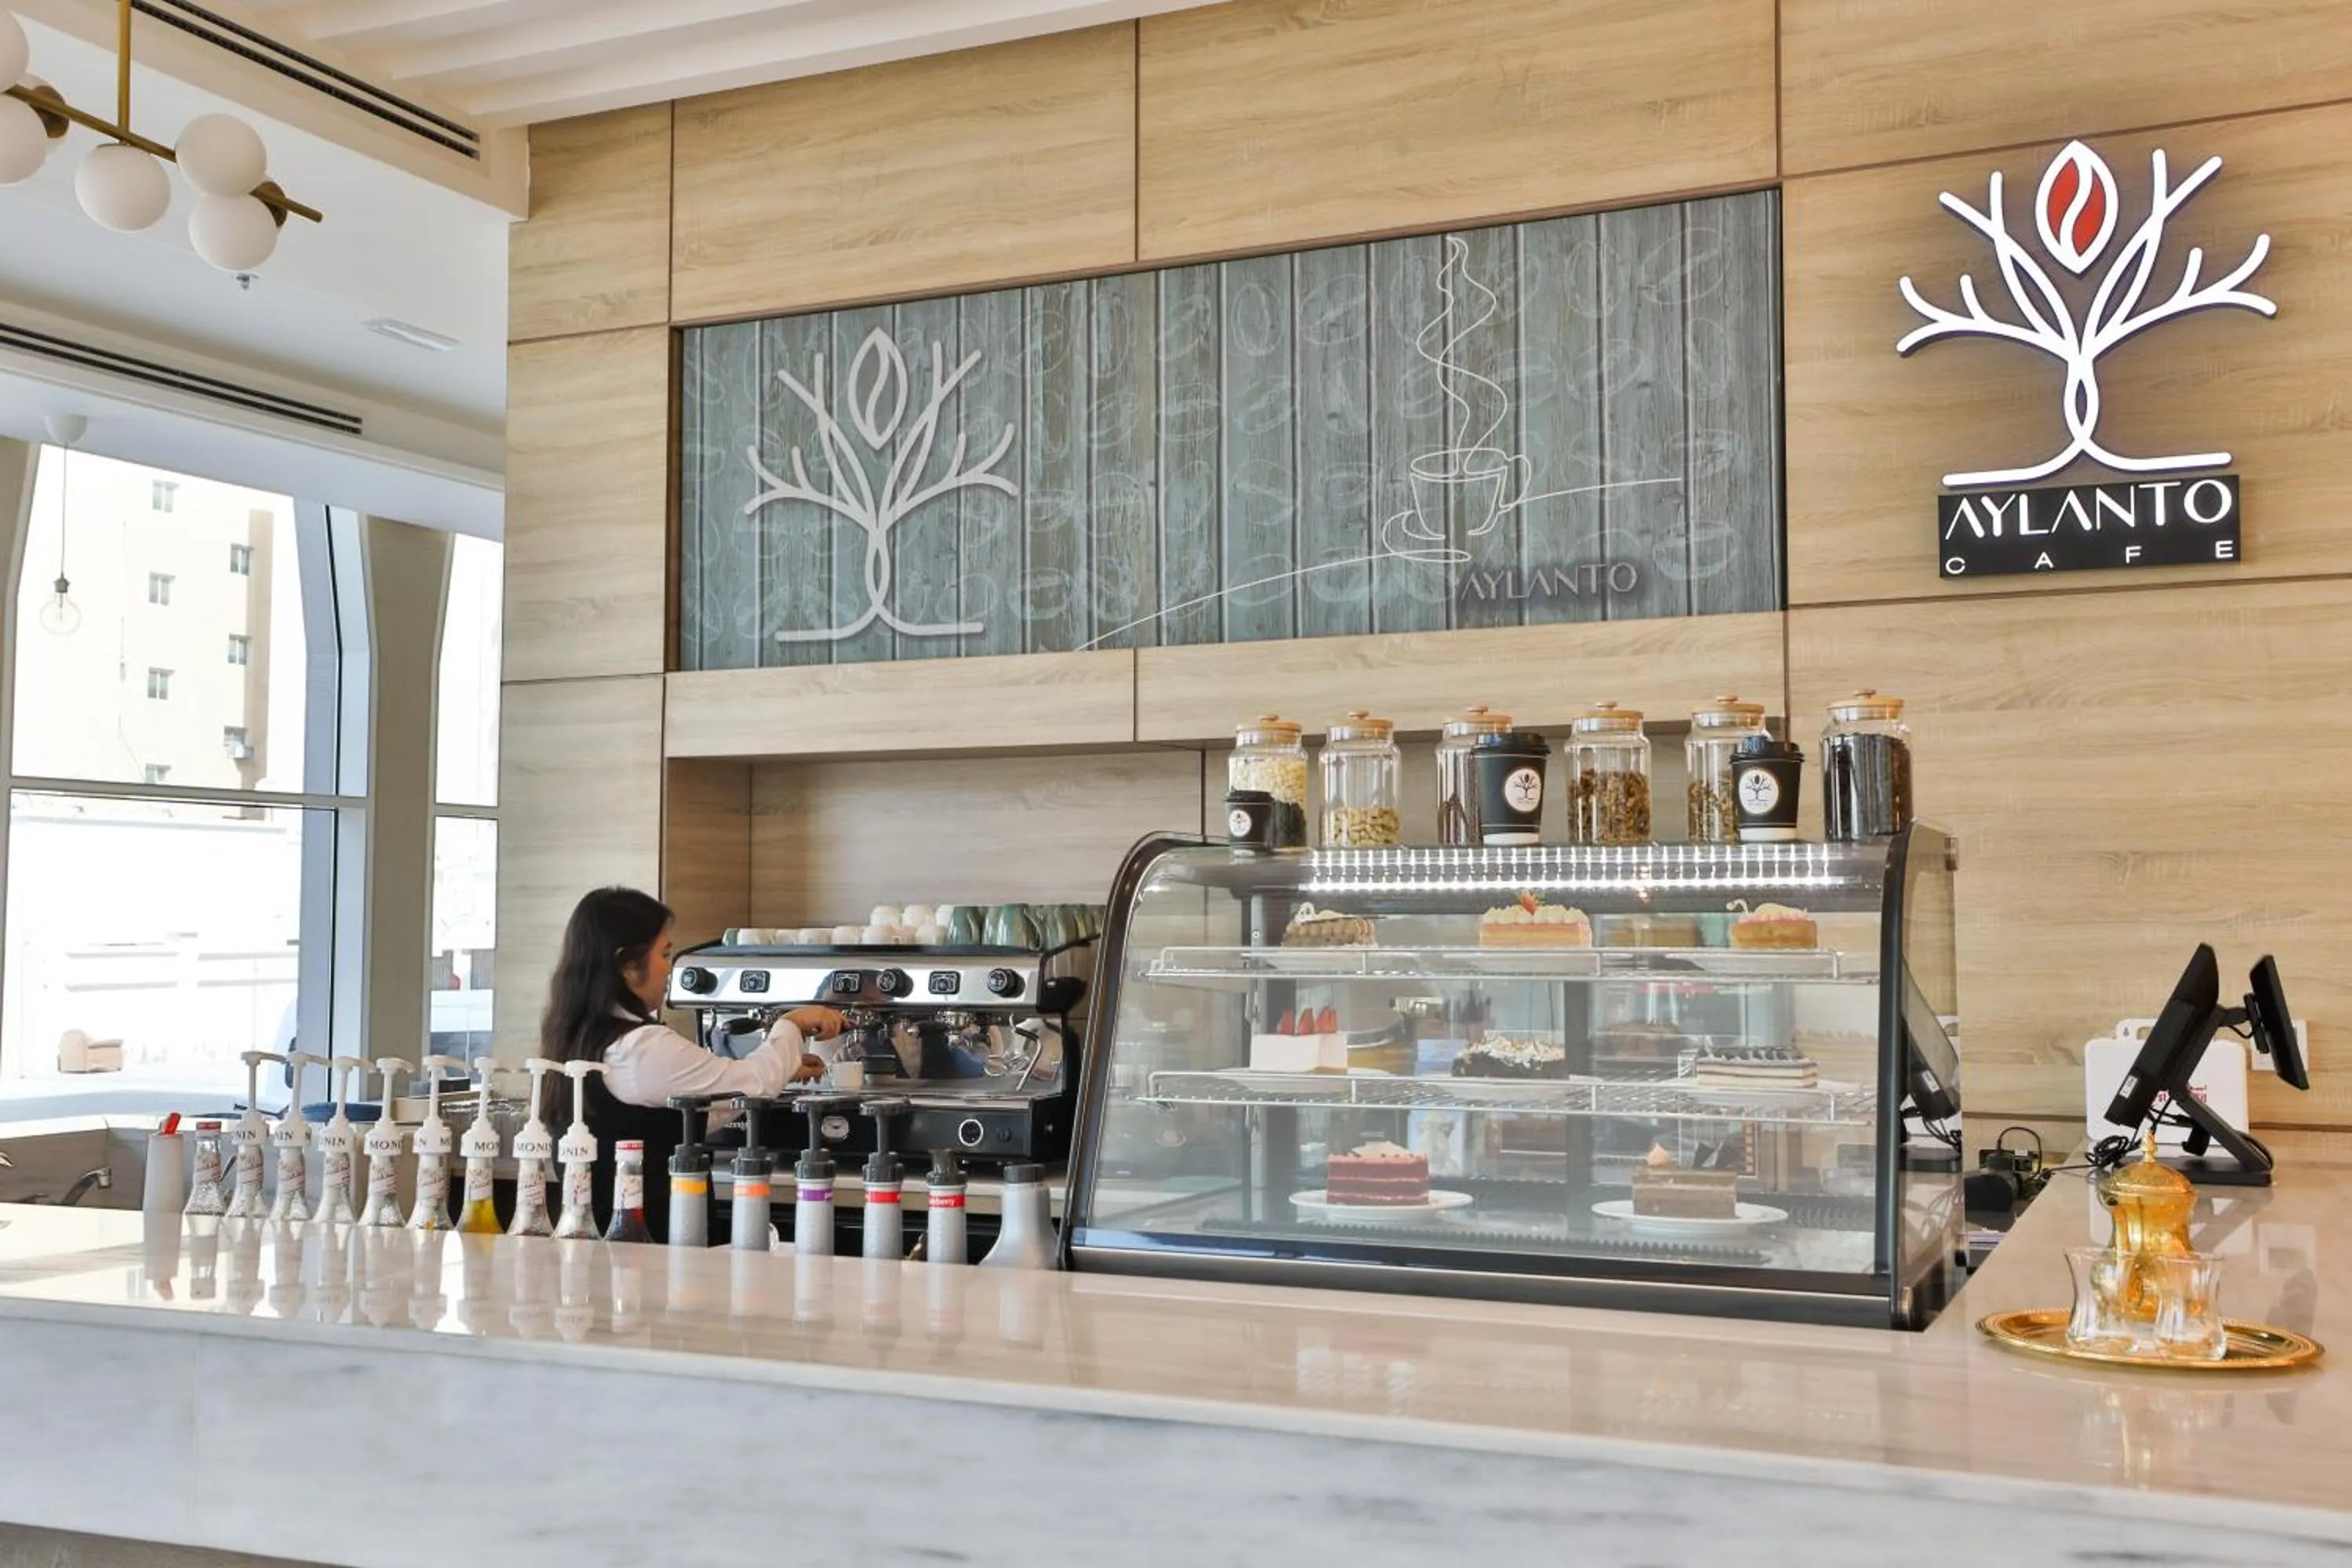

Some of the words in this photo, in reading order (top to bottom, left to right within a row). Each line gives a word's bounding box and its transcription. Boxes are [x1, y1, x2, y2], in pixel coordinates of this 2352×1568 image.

[1945, 479, 2232, 539] AYLANTO
[1945, 540, 2234, 574] CAFE
[1461, 561, 1638, 601] AYLANTO
[369, 1140, 403, 1150] MONI
